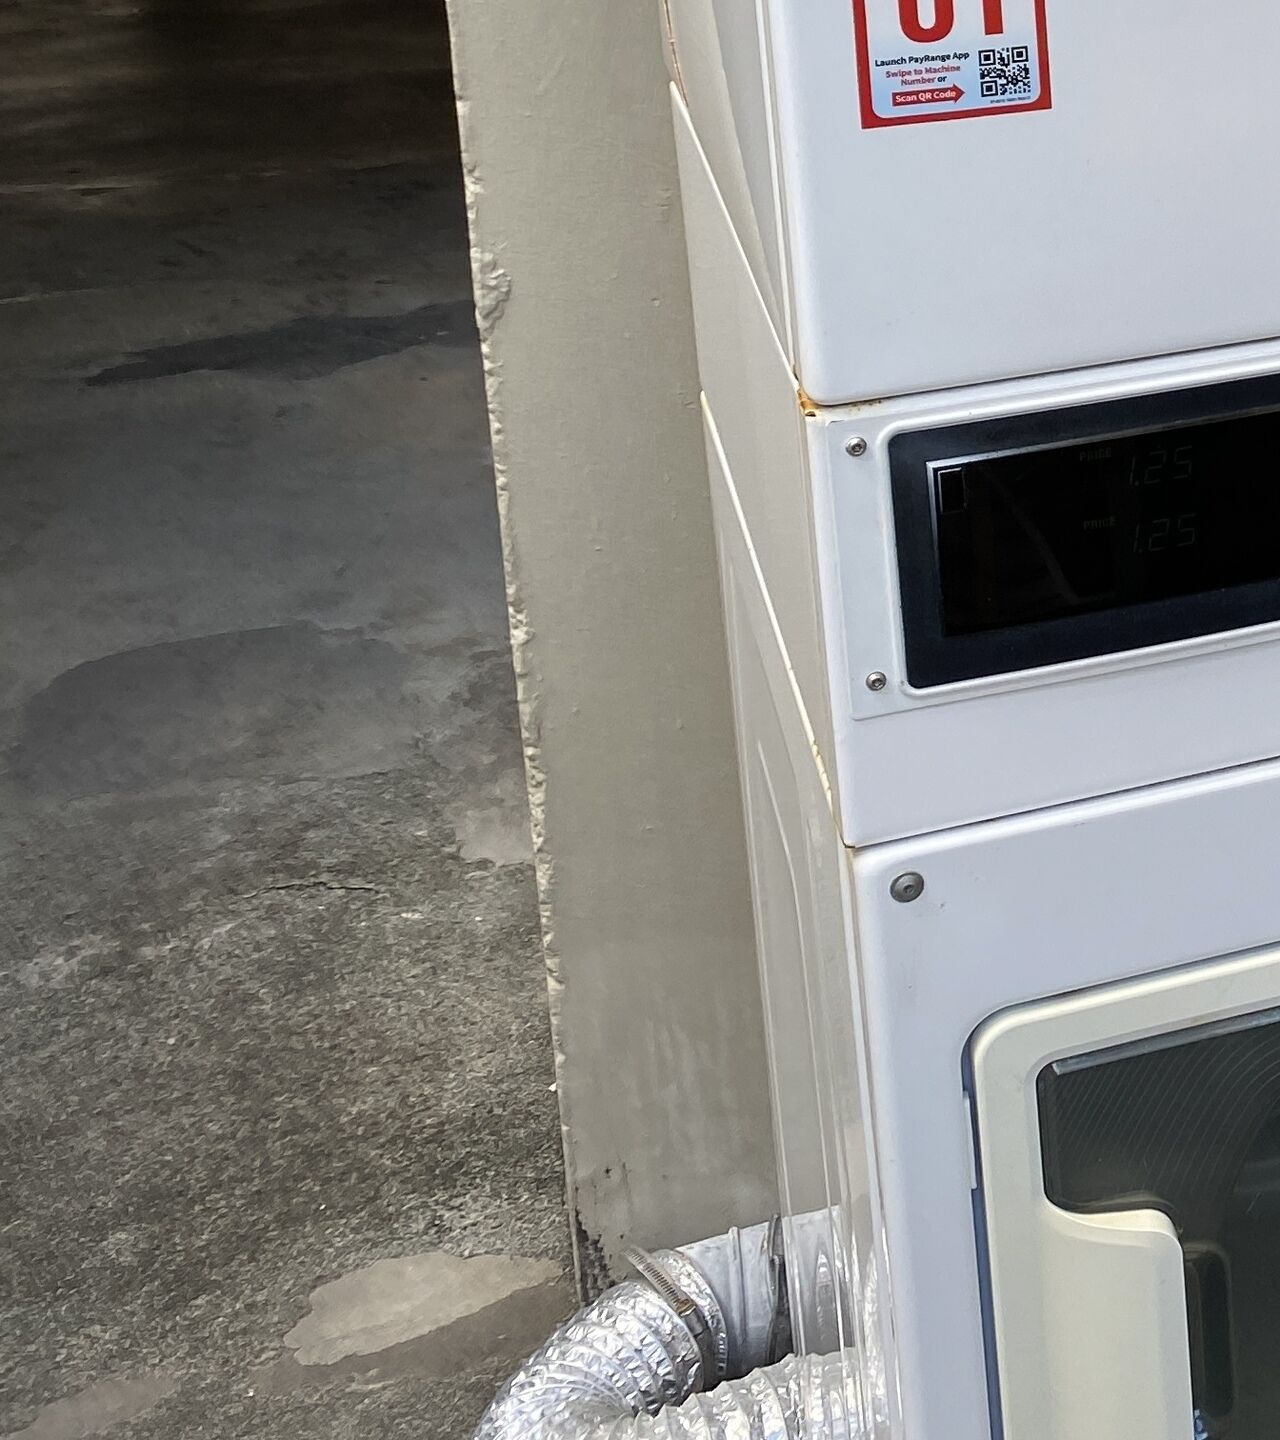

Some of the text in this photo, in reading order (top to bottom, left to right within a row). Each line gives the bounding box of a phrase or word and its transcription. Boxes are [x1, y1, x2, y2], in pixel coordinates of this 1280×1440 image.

[875, 51, 969, 67] Launch PayRange App
[886, 68, 912, 79] Swipe
[925, 64, 961, 74] Machine
[901, 75, 947, 86] Number or
[895, 89, 957, 103] Scan QR Code
[1133, 513, 1196, 553] 1.25
